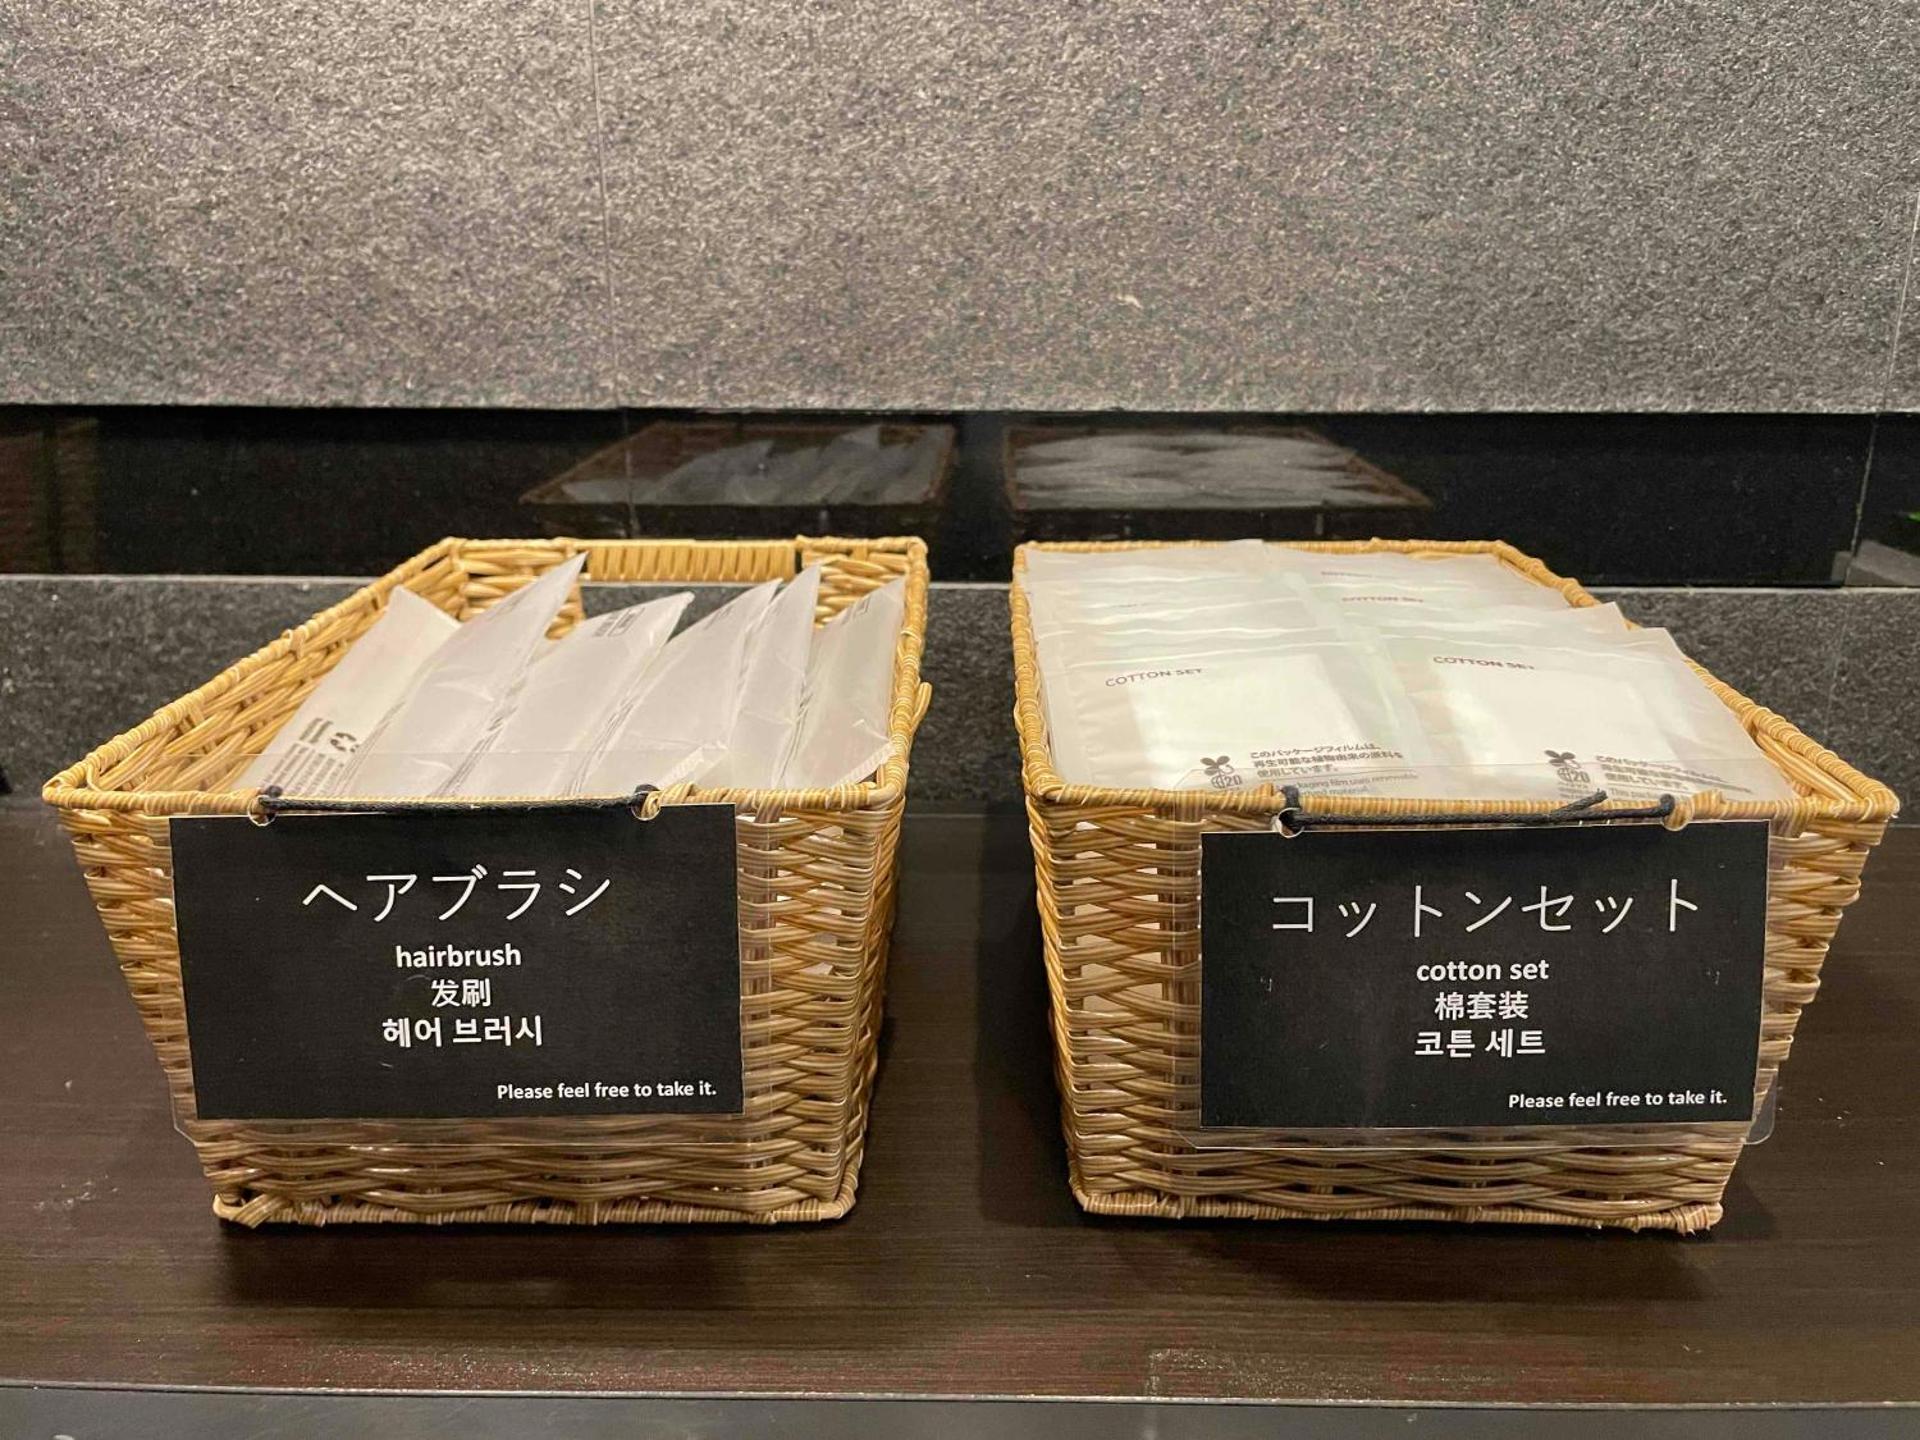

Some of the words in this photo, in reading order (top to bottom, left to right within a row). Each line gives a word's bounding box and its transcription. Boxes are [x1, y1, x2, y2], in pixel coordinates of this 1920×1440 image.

[1432, 655, 1504, 668] COTTON
[1105, 670, 1171, 687] COTTON
[302, 863, 611, 922] ヘアブラシ
[1272, 877, 1699, 939] コットンセット
[395, 943, 522, 969] hairbrush
[1416, 960, 1502, 982] cotton
[1509, 959, 1550, 980] set
[430, 977, 491, 1008] 发刷
[1434, 990, 1529, 1021] 棉套装
[382, 1016, 442, 1048] 헤어
[452, 1014, 543, 1047] 브러시
[1414, 1029, 1476, 1058] 코튼
[1484, 1028, 1546, 1058] 세트
[497, 1083, 554, 1100] Please
[557, 1082, 590, 1099] feel
[594, 1081, 629, 1098] free
[634, 1083, 653, 1097] to
[657, 1081, 695, 1097] take
[698, 1080, 717, 1096] it.
[1508, 1092, 1565, 1108] Please
[1568, 1091, 1601, 1107] feel
[1605, 1091, 1641, 1107] free
[1645, 1092, 1664, 1106] to
[1668, 1090, 1706, 1106] take
[1709, 1090, 1728, 1104] it.
